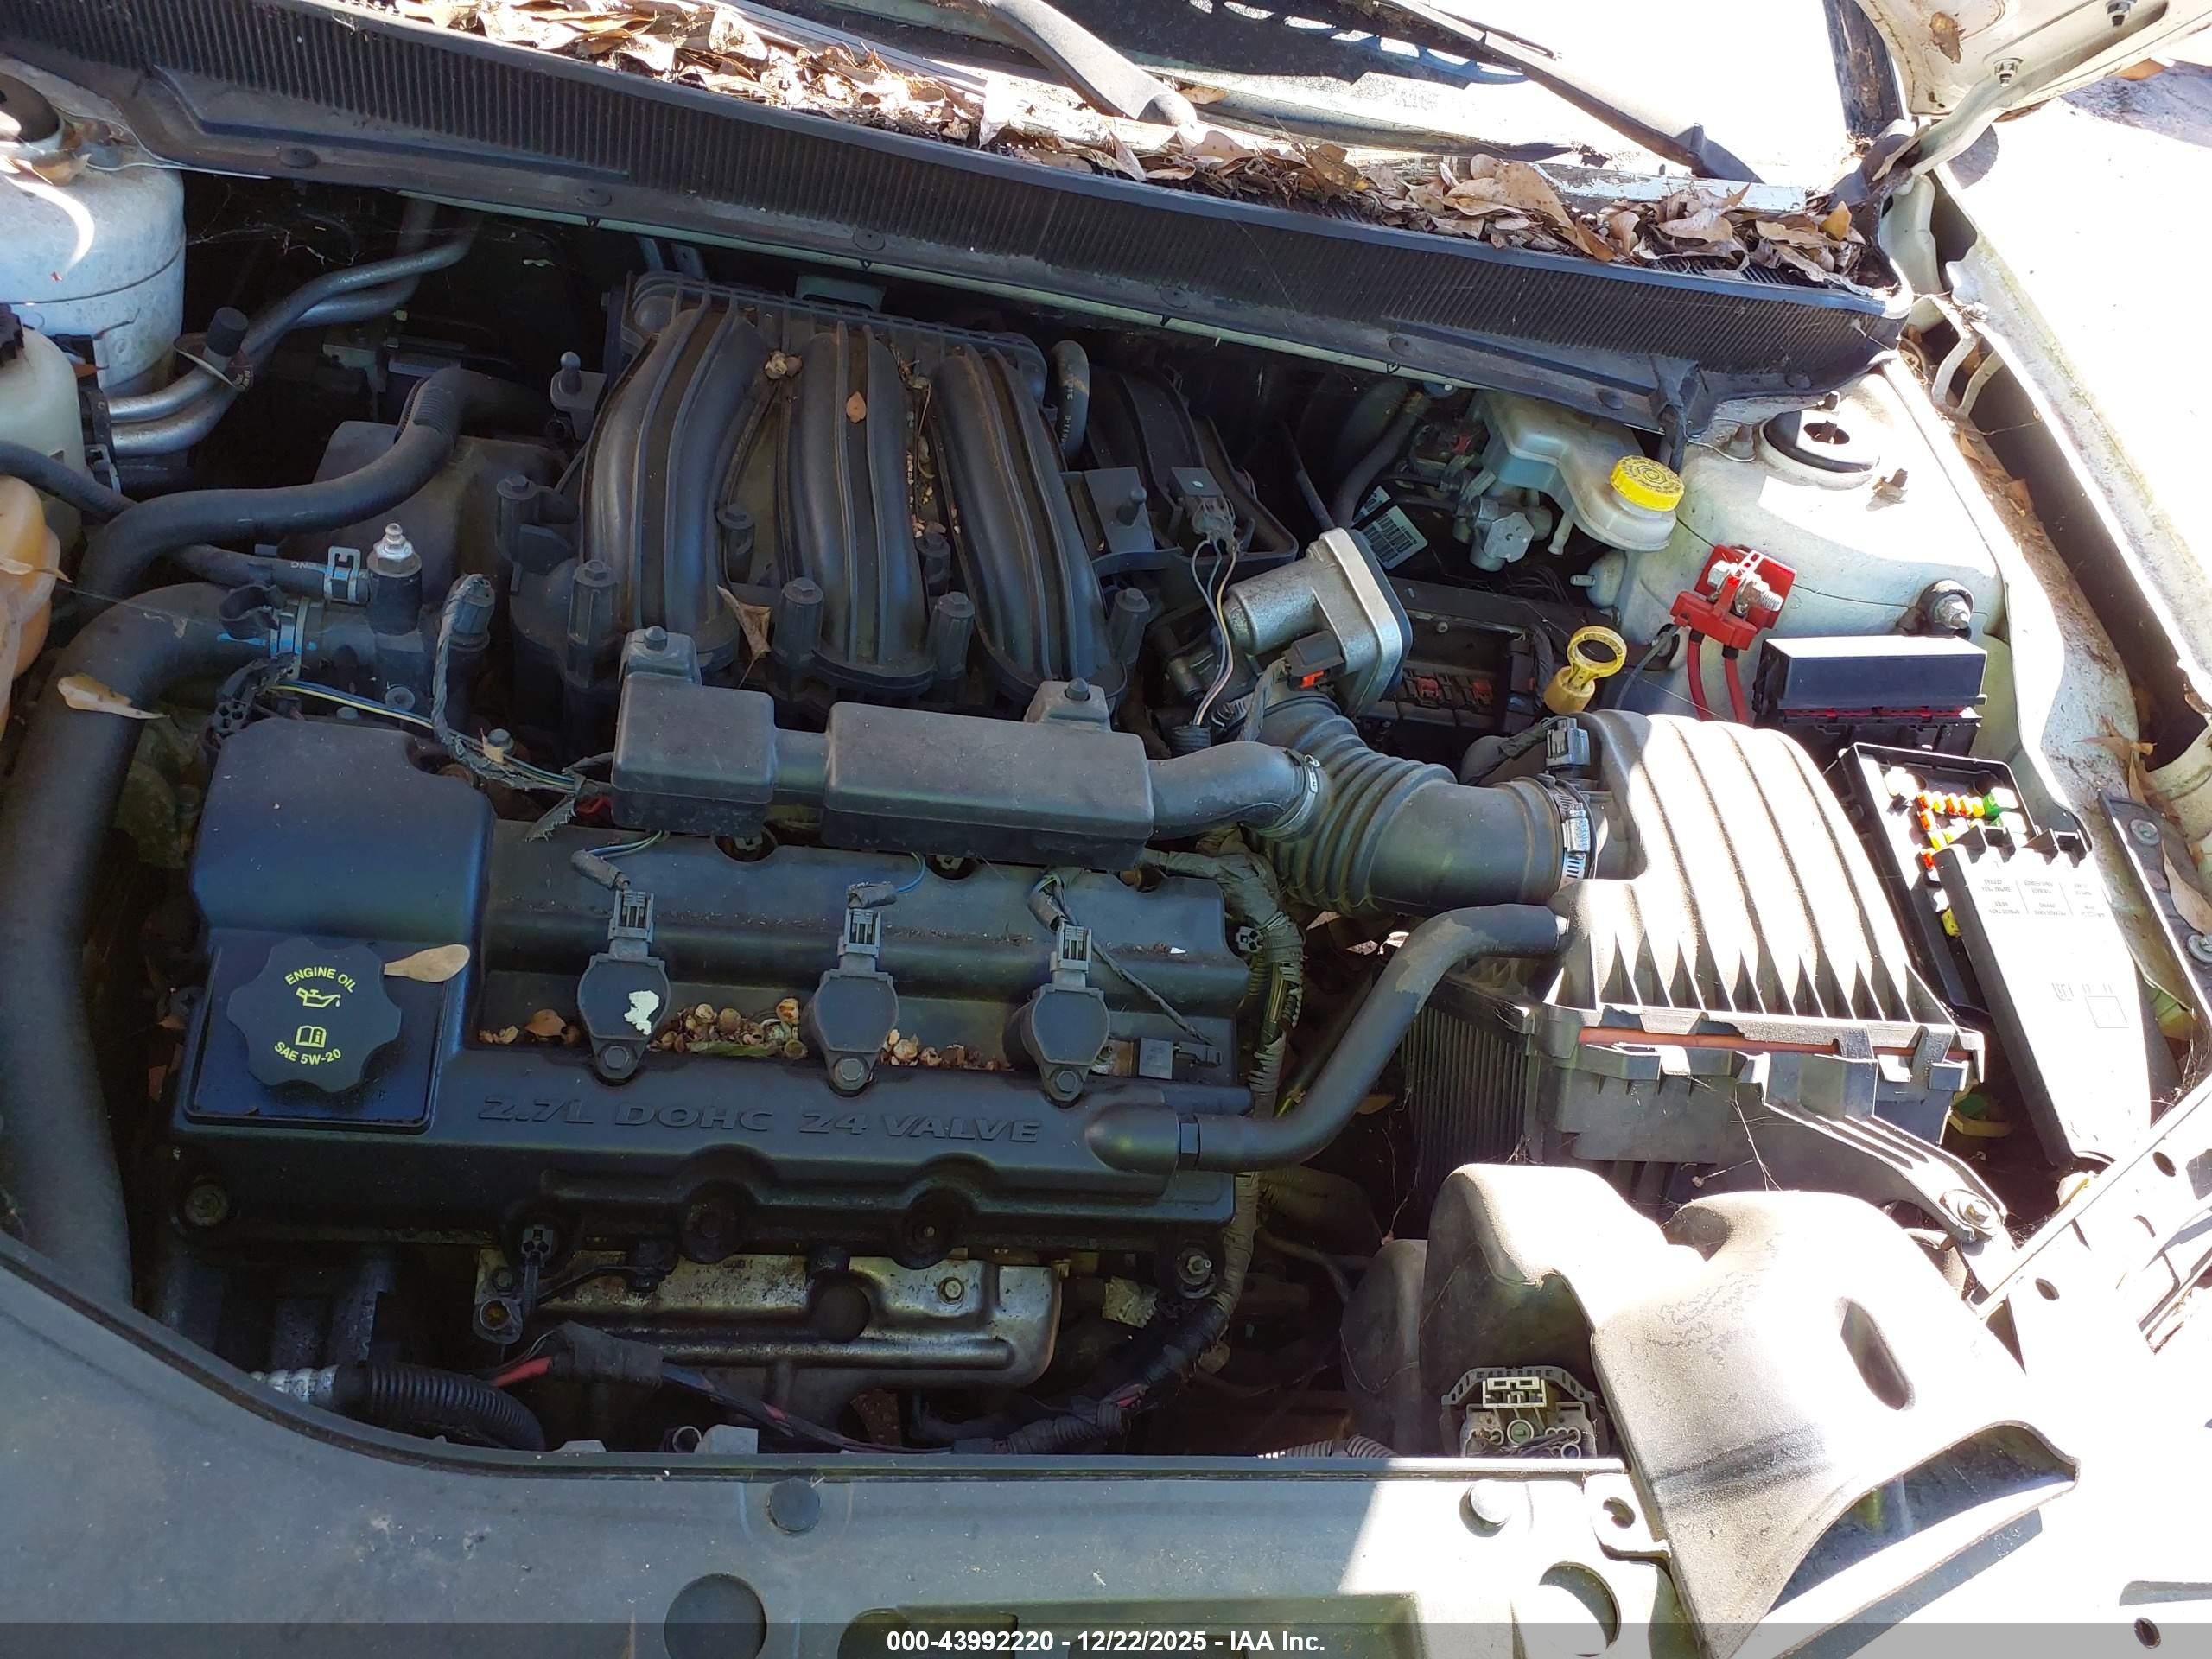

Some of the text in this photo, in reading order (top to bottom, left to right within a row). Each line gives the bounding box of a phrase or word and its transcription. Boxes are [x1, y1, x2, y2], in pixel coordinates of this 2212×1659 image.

[285, 967, 356, 993] ENGINE OIL
[275, 1042, 341, 1065] SAE 5W-20
[478, 1096, 1043, 1143] 2.7L DOHC 24 VALVE
